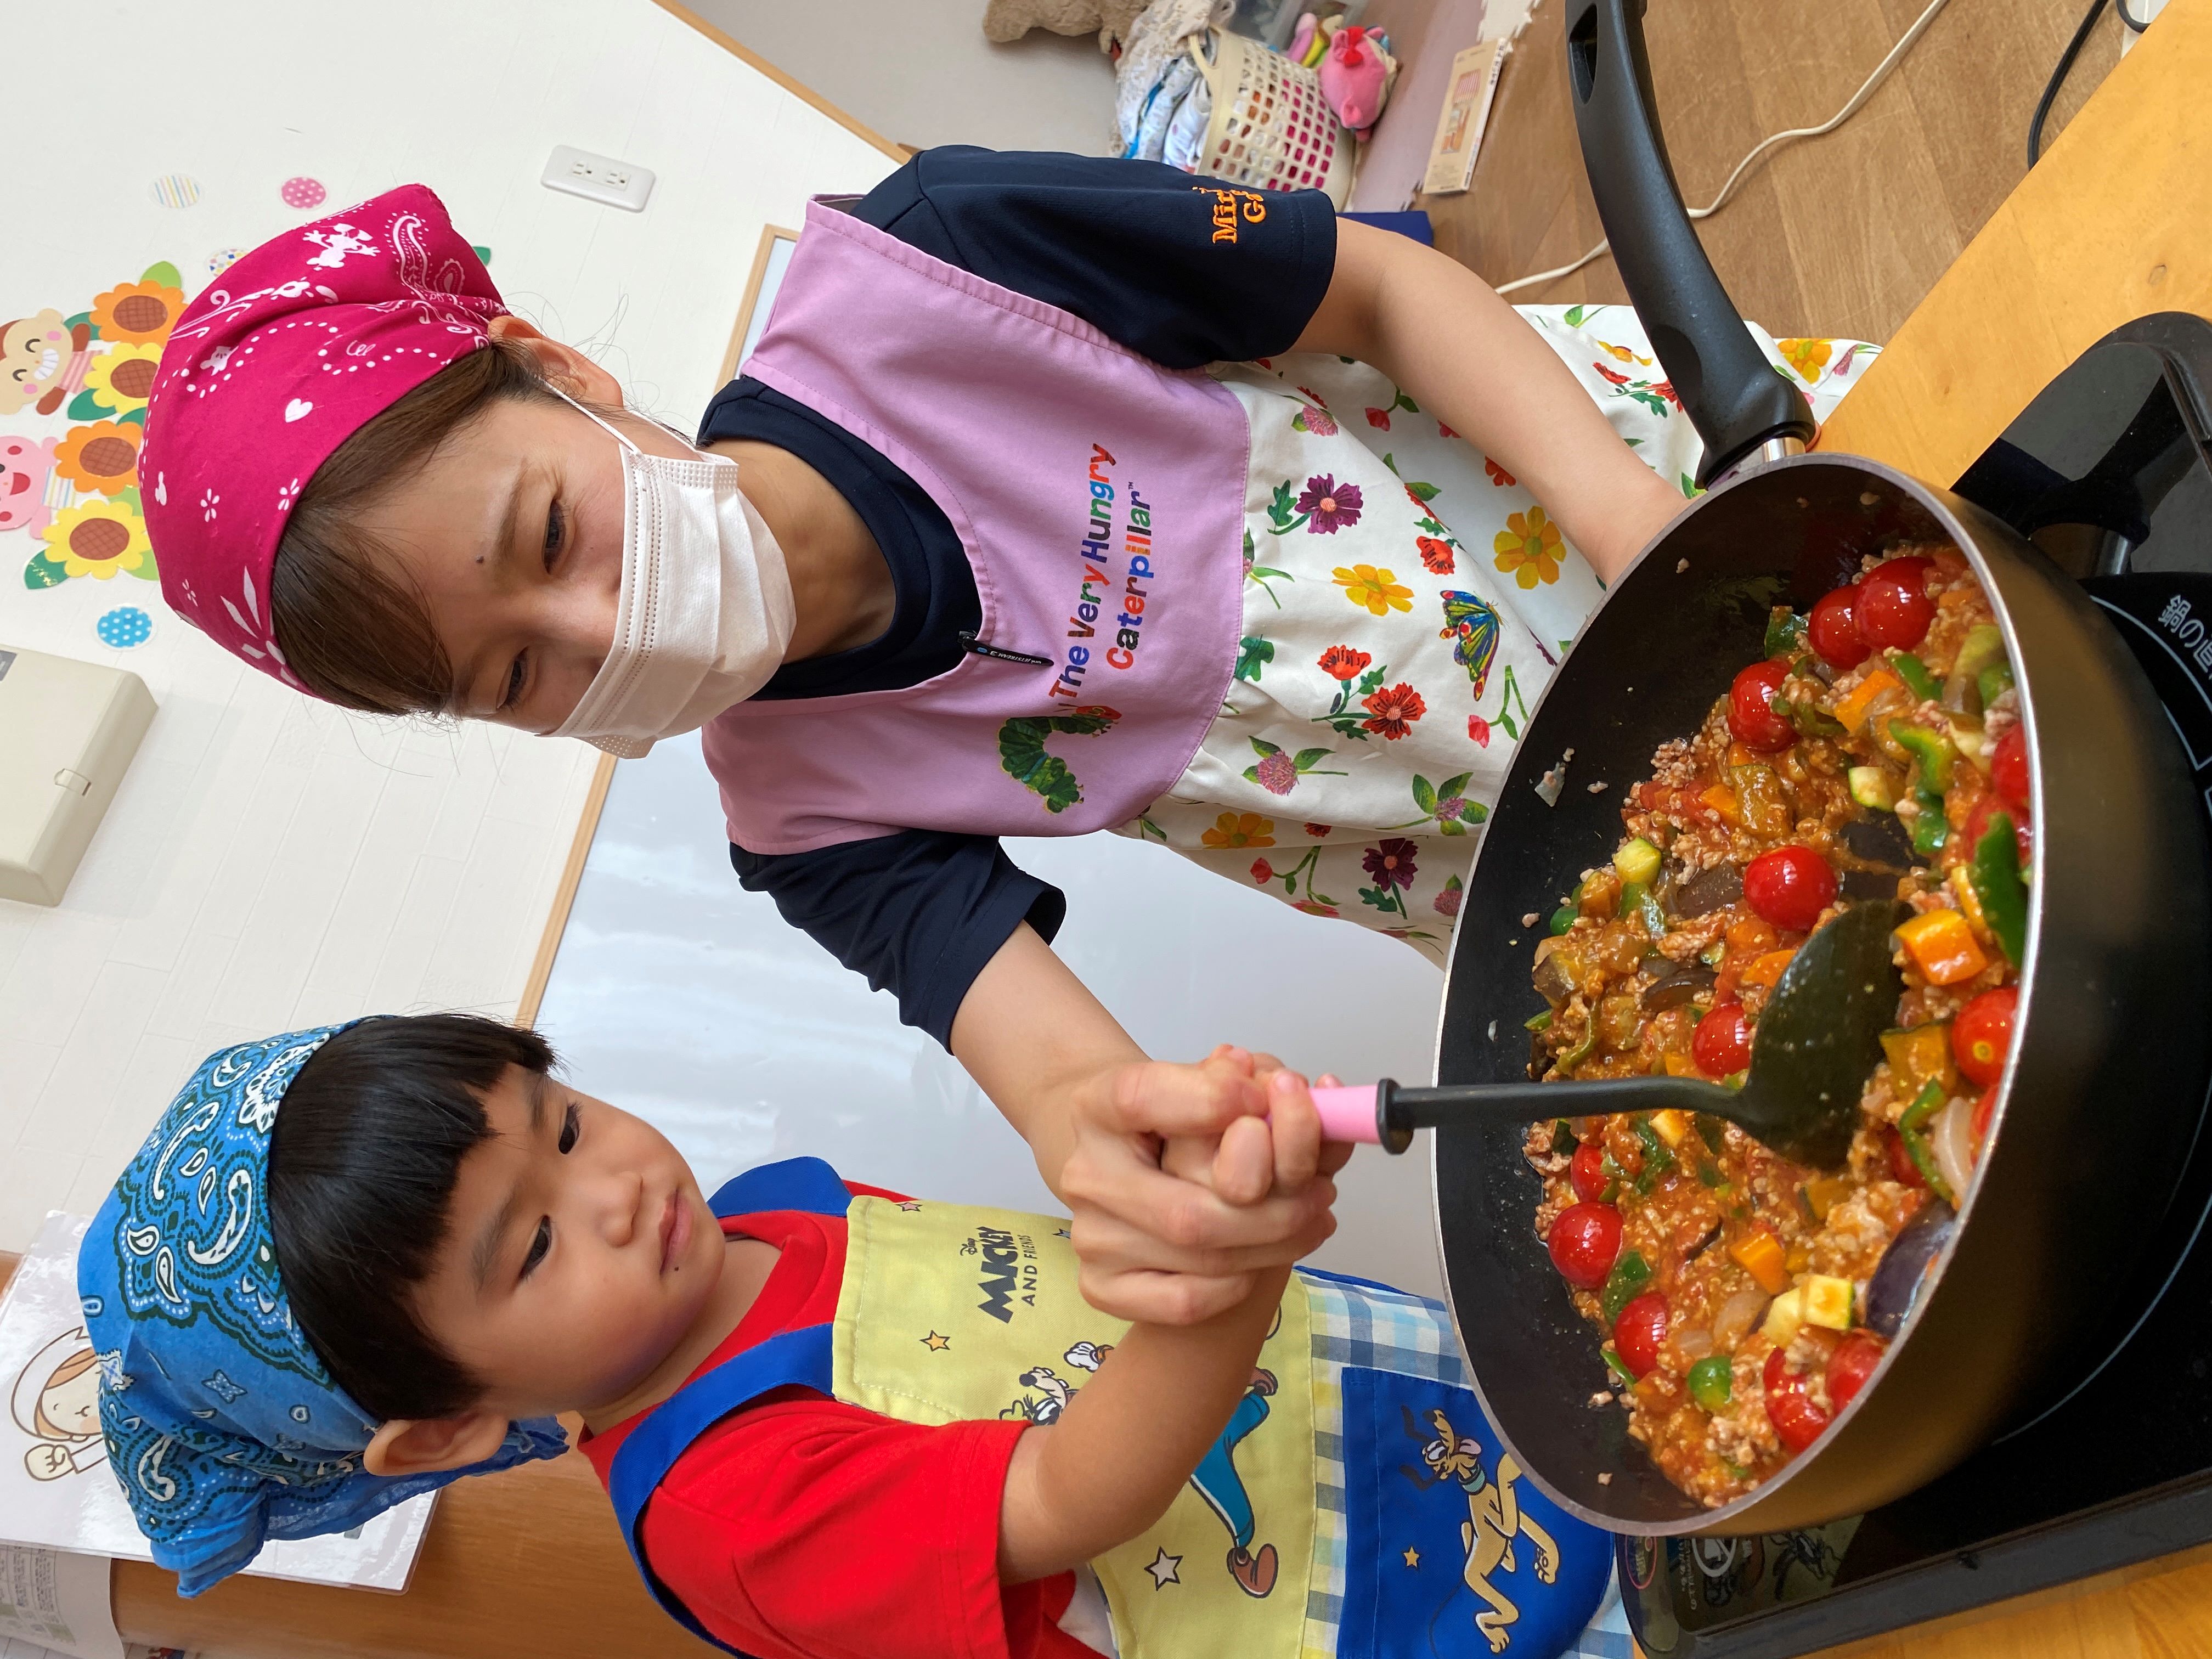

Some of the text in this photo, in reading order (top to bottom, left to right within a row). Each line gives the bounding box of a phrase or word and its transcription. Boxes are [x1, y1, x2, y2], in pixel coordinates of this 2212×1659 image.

[1048, 443, 1116, 698] The Very Hungry
[998, 653, 1031, 662] JETSTREAM
[976, 1226, 1018, 1323] MICKEY
[1017, 1234, 1037, 1307] AND FRIENDS
